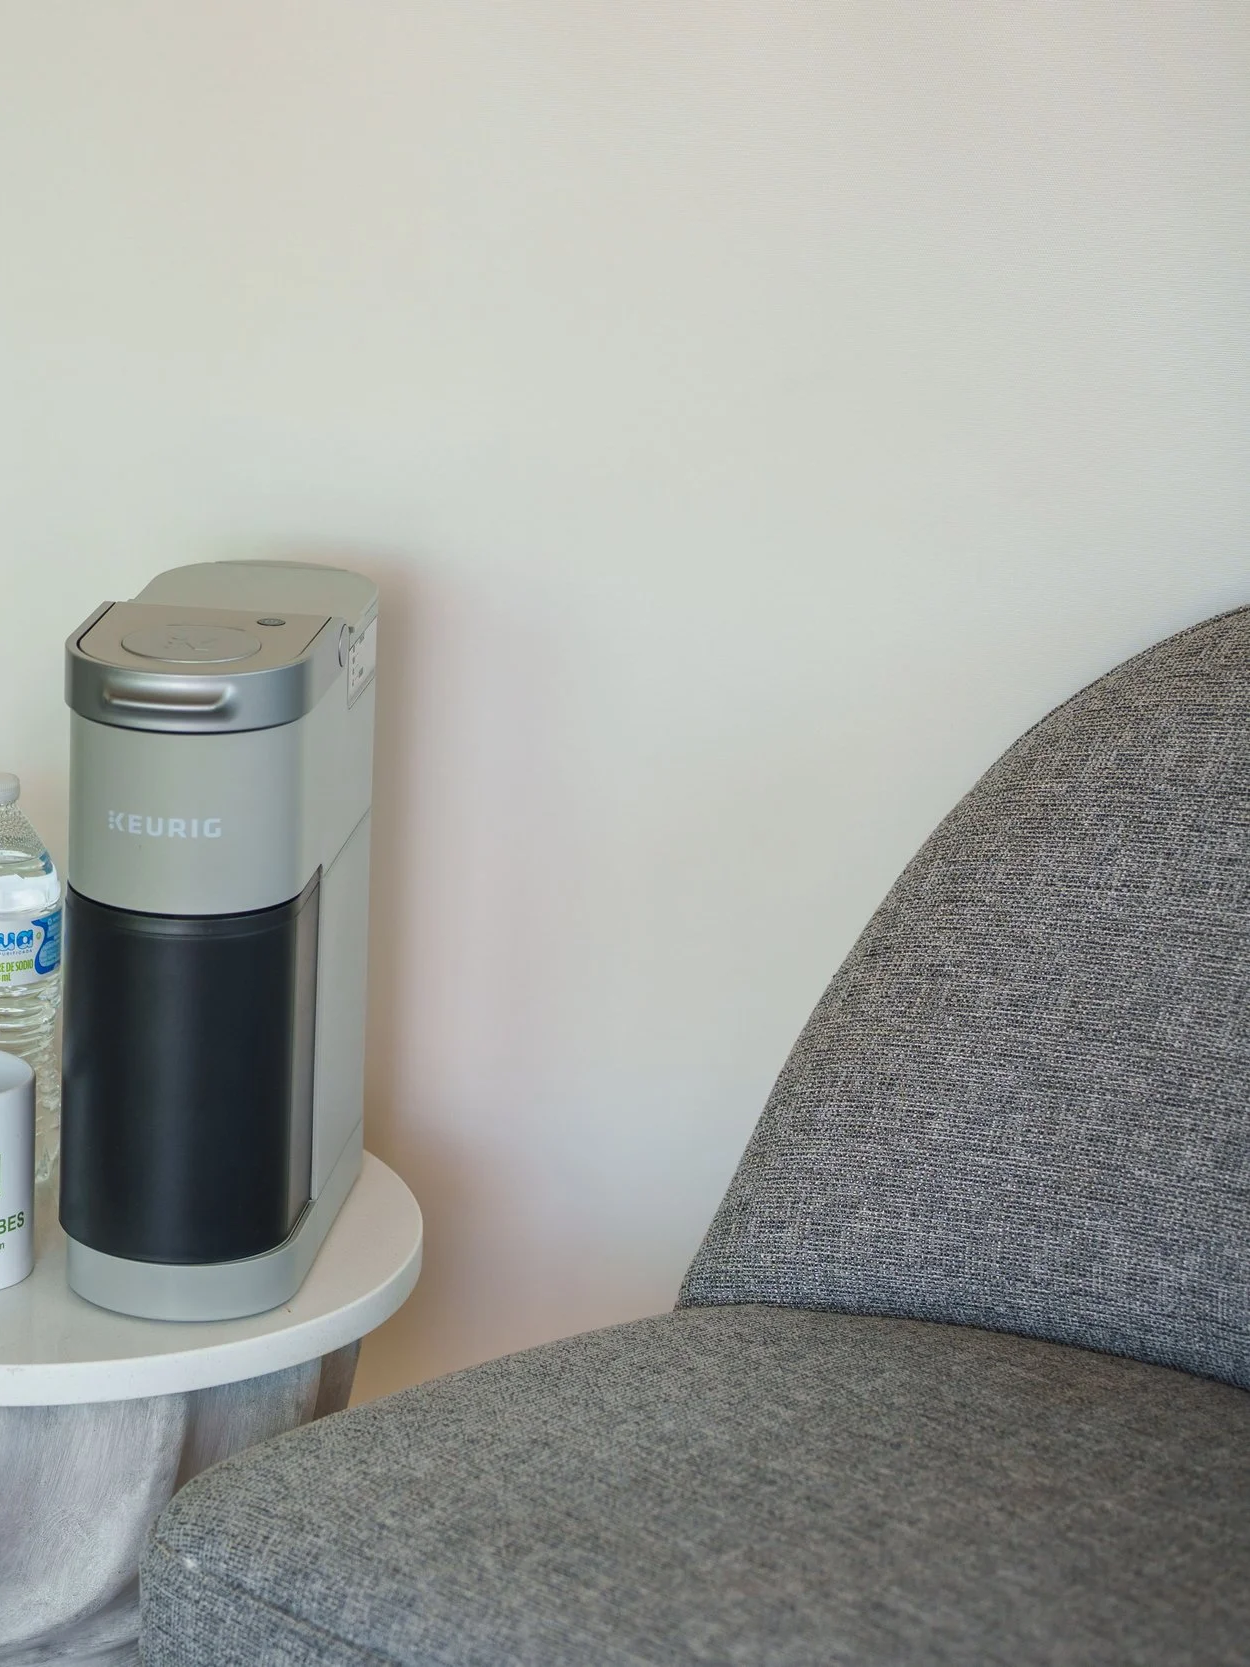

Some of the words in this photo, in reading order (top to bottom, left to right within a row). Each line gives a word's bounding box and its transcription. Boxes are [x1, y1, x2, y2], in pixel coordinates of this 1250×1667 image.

[108, 810, 222, 839] KEURIG
[6, 961, 15, 972] DE
[15, 958, 34, 970] SODIO
